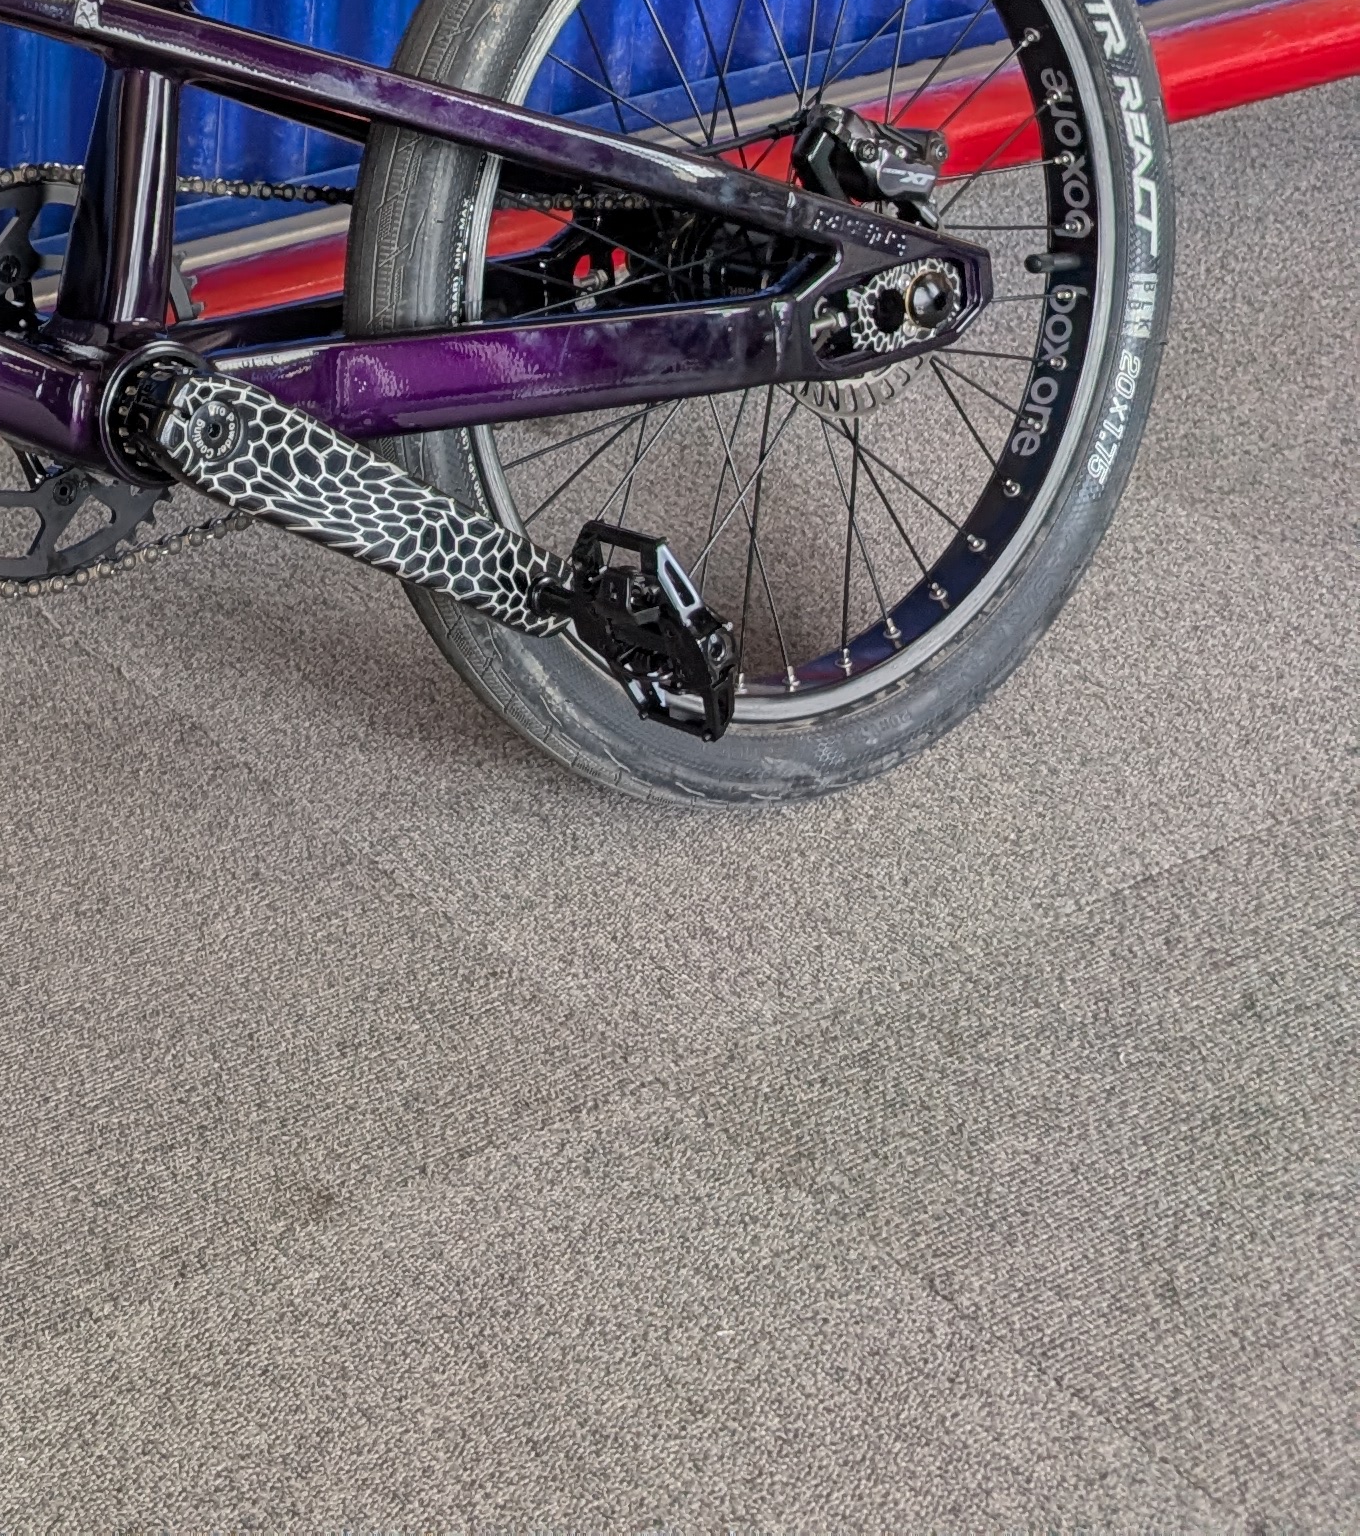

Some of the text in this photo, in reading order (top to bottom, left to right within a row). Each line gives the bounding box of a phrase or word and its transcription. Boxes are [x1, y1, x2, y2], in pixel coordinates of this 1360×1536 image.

[1116, 75, 1160, 257] REACT
[1011, 284, 1088, 457] box one
[192, 418, 215, 459] Coating
[216, 412, 235, 457] Powder
